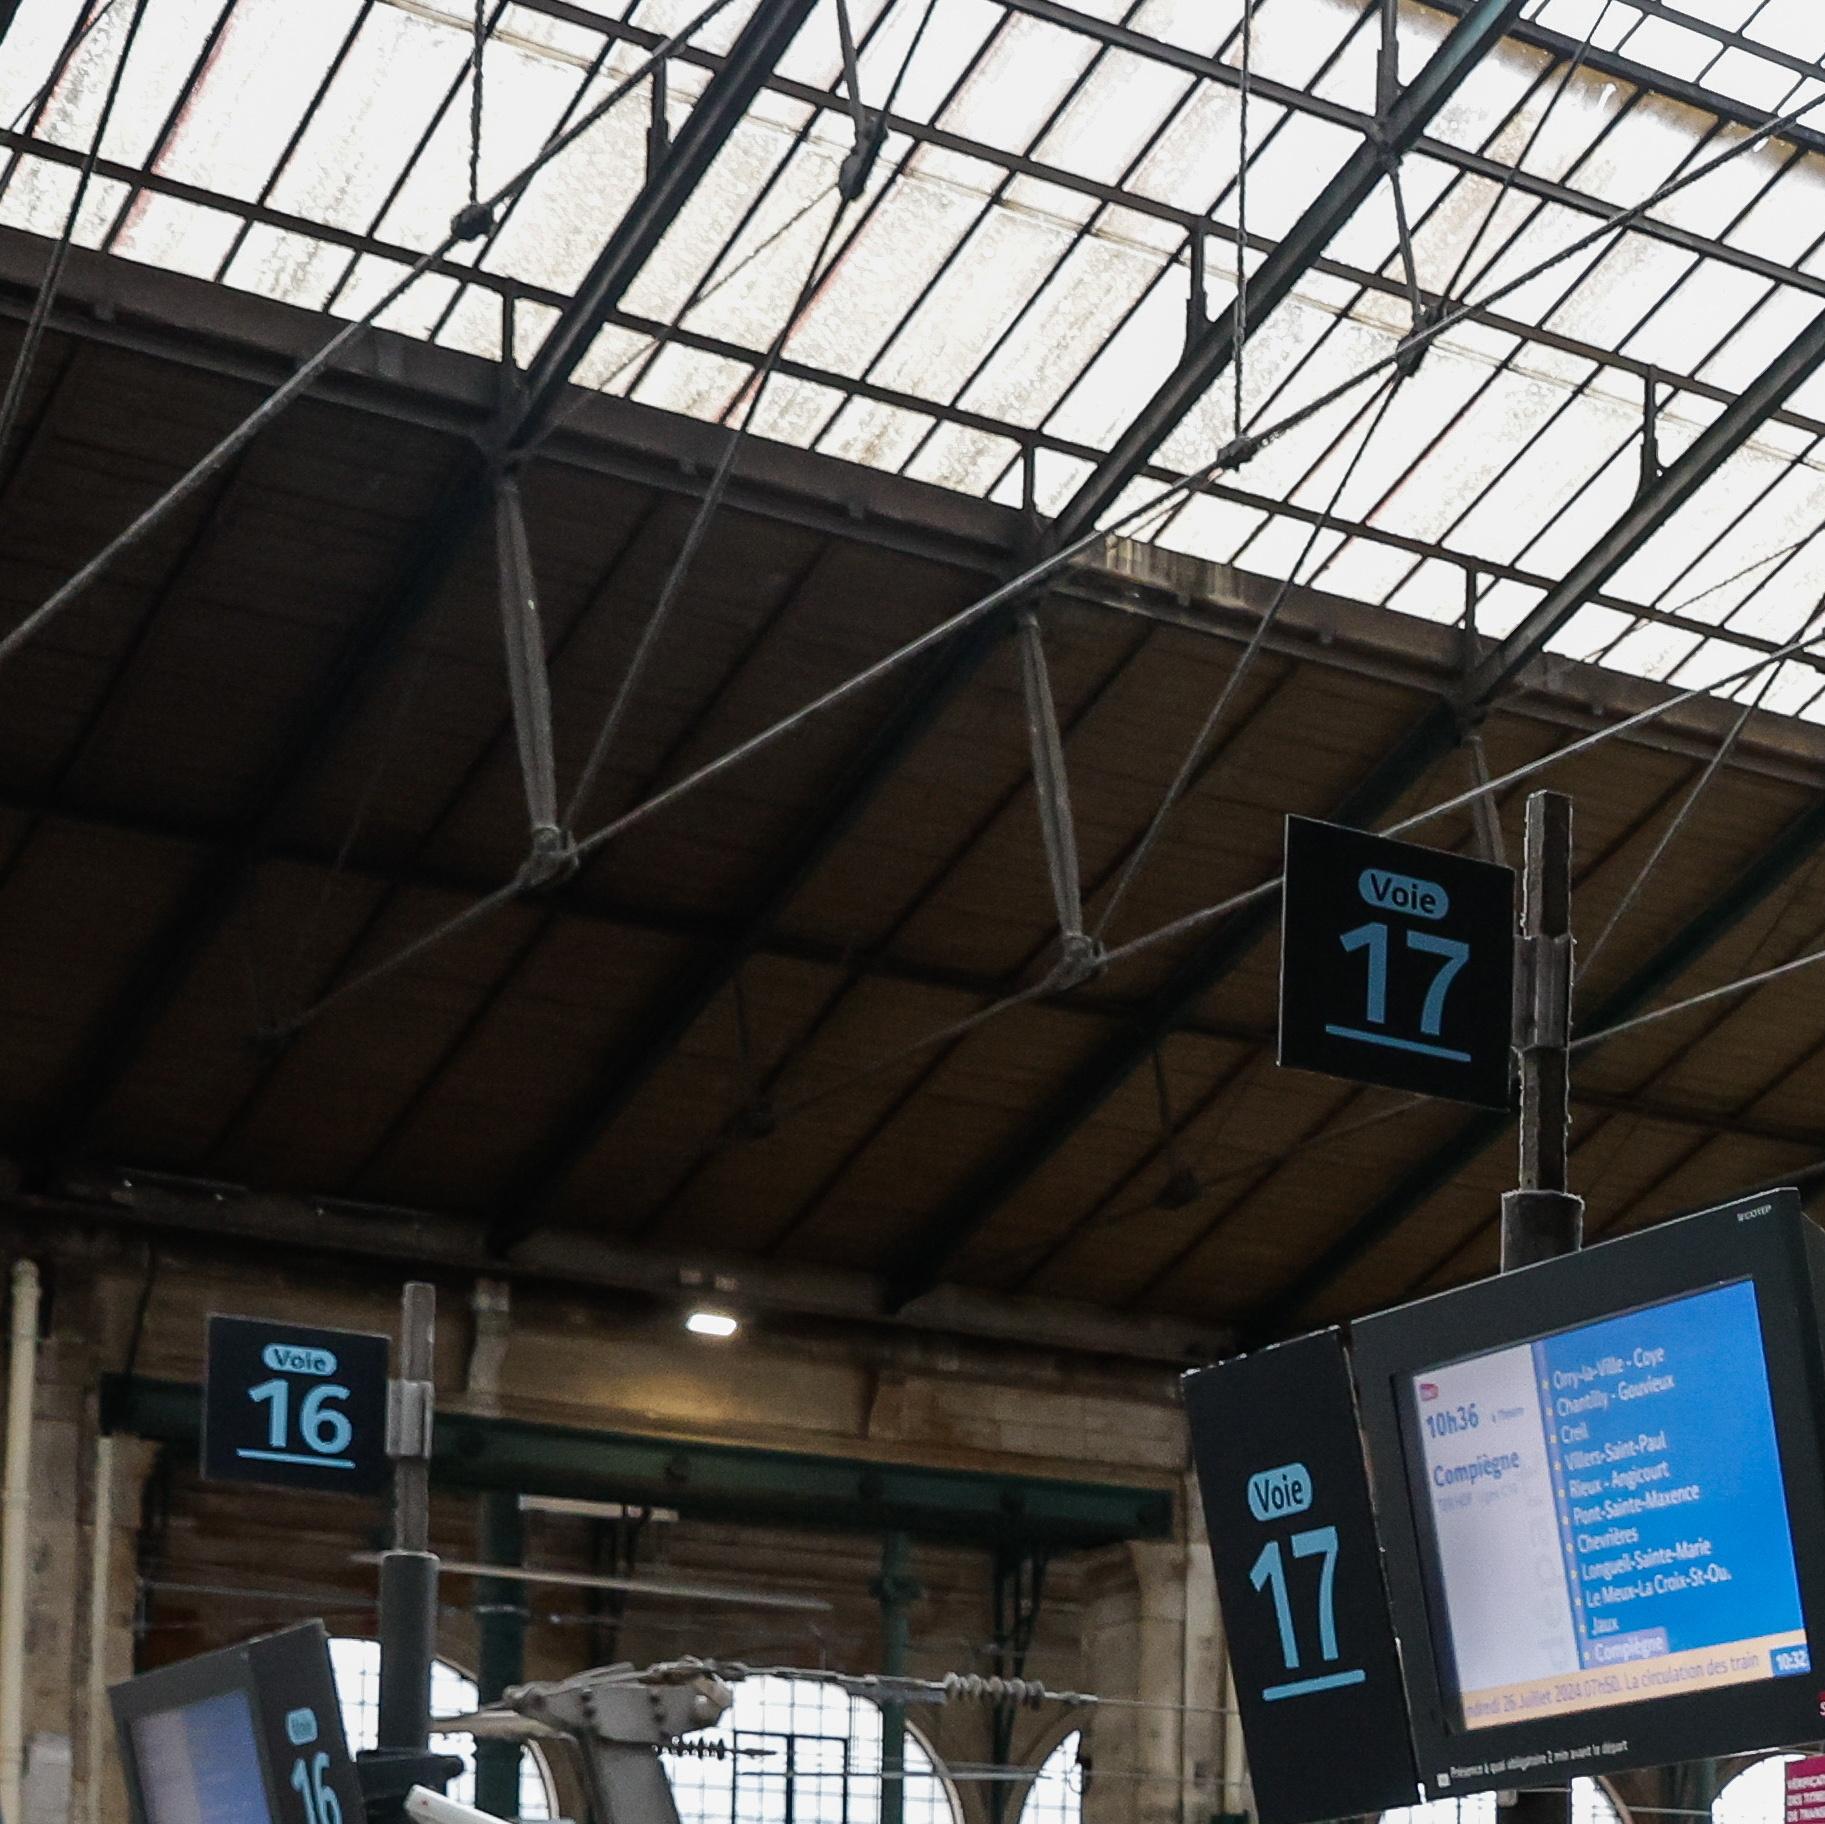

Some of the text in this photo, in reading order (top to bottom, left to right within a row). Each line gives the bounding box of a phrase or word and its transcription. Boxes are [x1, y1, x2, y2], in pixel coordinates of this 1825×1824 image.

[1371, 873, 1436, 914] Voie
[1339, 921, 1470, 1036] 17
[274, 1348, 327, 1371] Voie
[248, 1378, 352, 1454] 16
[1425, 1403, 1479, 1439] 10h36
[1254, 1474, 1304, 1513] Voie
[1250, 1525, 1339, 1668] 17
[1706, 1656, 1728, 1676] des
[1775, 1650, 1809, 1671] 10:32
